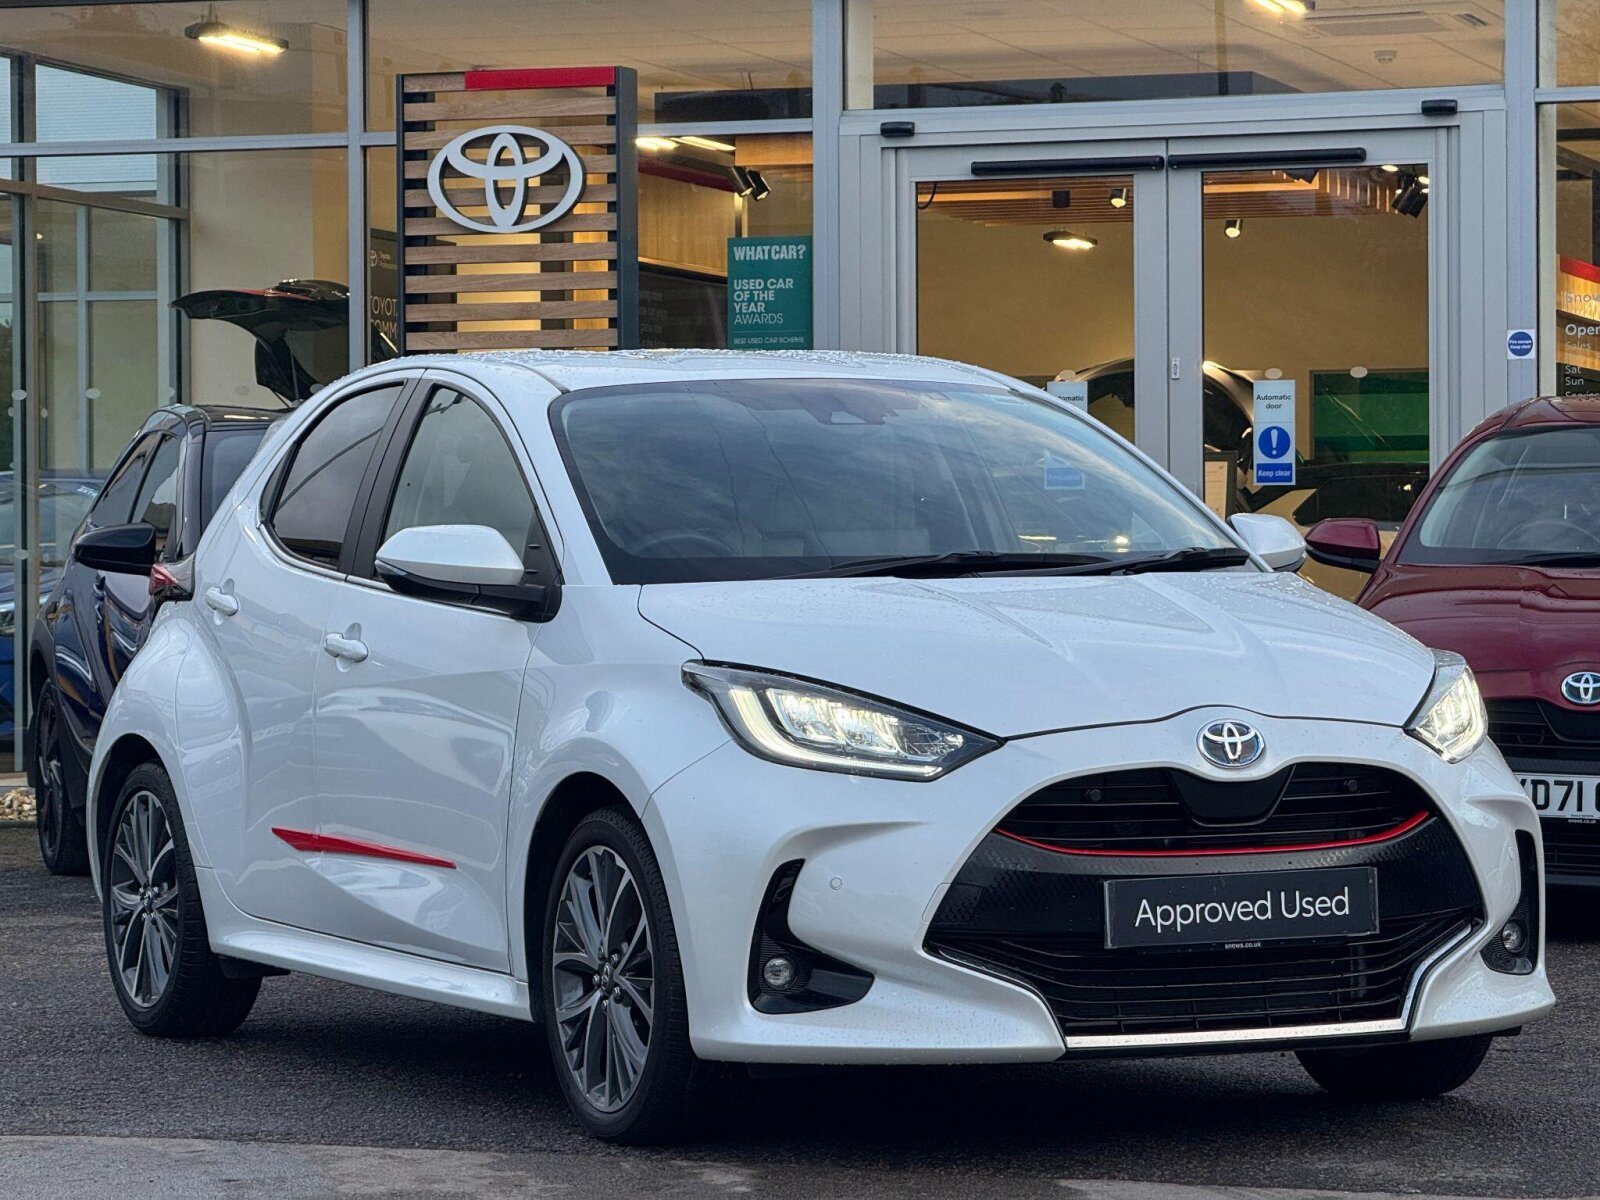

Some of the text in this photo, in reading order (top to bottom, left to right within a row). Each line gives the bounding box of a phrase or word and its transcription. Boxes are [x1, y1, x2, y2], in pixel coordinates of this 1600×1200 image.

[734, 245, 806, 261] WHAT CAR?
[733, 278, 794, 290] USED CAR
[733, 290, 775, 301] OF THE
[734, 302, 765, 313] YEAR
[734, 313, 784, 325] AWARDS
[733, 337, 747, 345] BEST
[764, 336, 778, 344] CAR
[779, 336, 805, 344] SCHEME
[1565, 341, 1591, 350] Sales
[1565, 365, 1581, 374] Sat
[1565, 376, 1584, 386] Sun
[1258, 469, 1291, 478] Keep clear
[1520, 778, 1583, 812] D71
[1134, 886, 1349, 933] Approved Used
[1225, 941, 1262, 949] snows.co.uk
